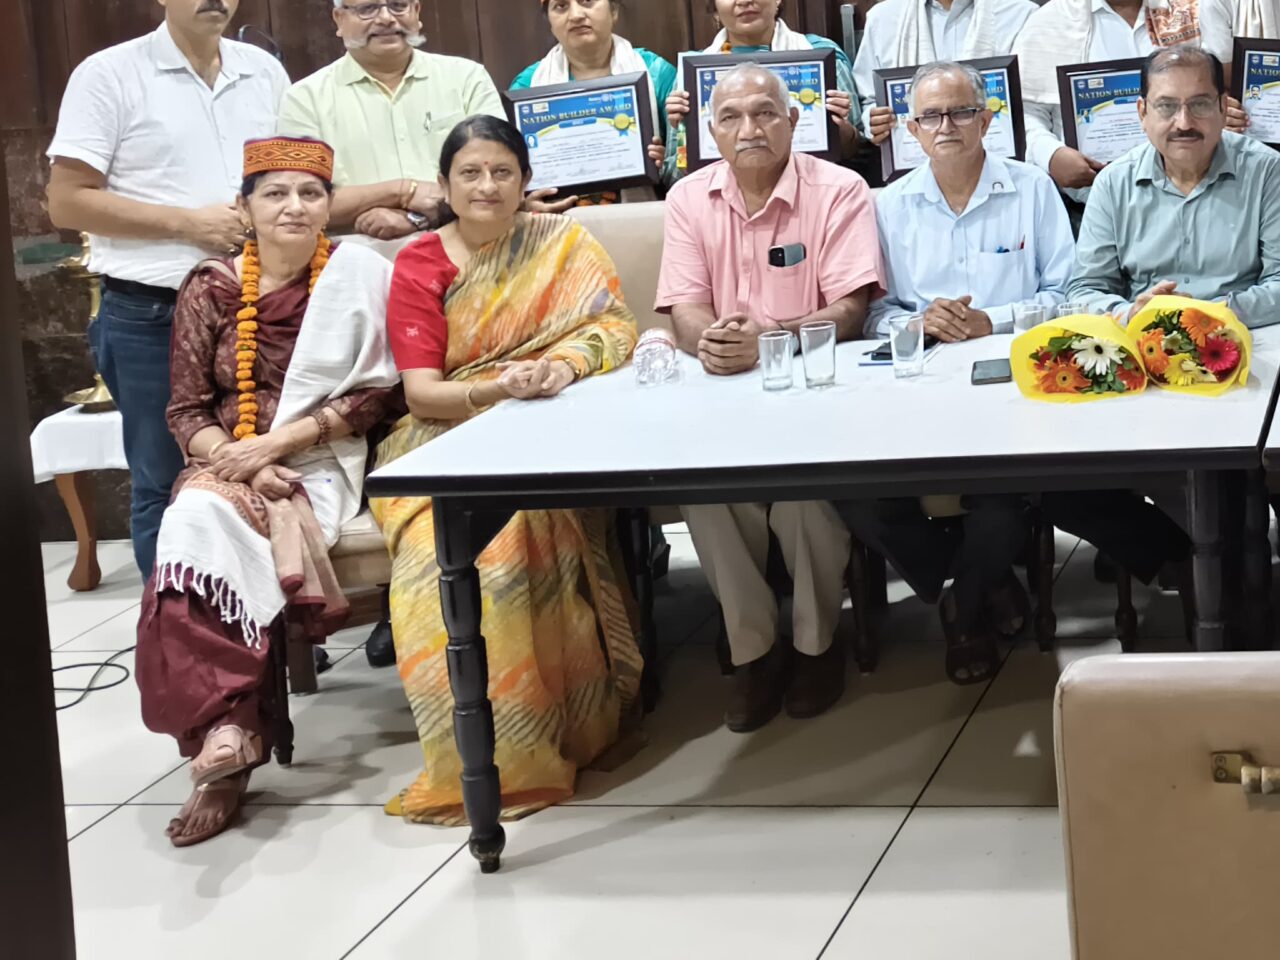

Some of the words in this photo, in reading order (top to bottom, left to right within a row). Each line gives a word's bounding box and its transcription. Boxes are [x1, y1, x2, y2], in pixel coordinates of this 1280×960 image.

[1078, 90, 1112, 99] NATION
[522, 113, 557, 125] NATION
[559, 108, 597, 120] BUILDER
[599, 103, 632, 114] AWARD
